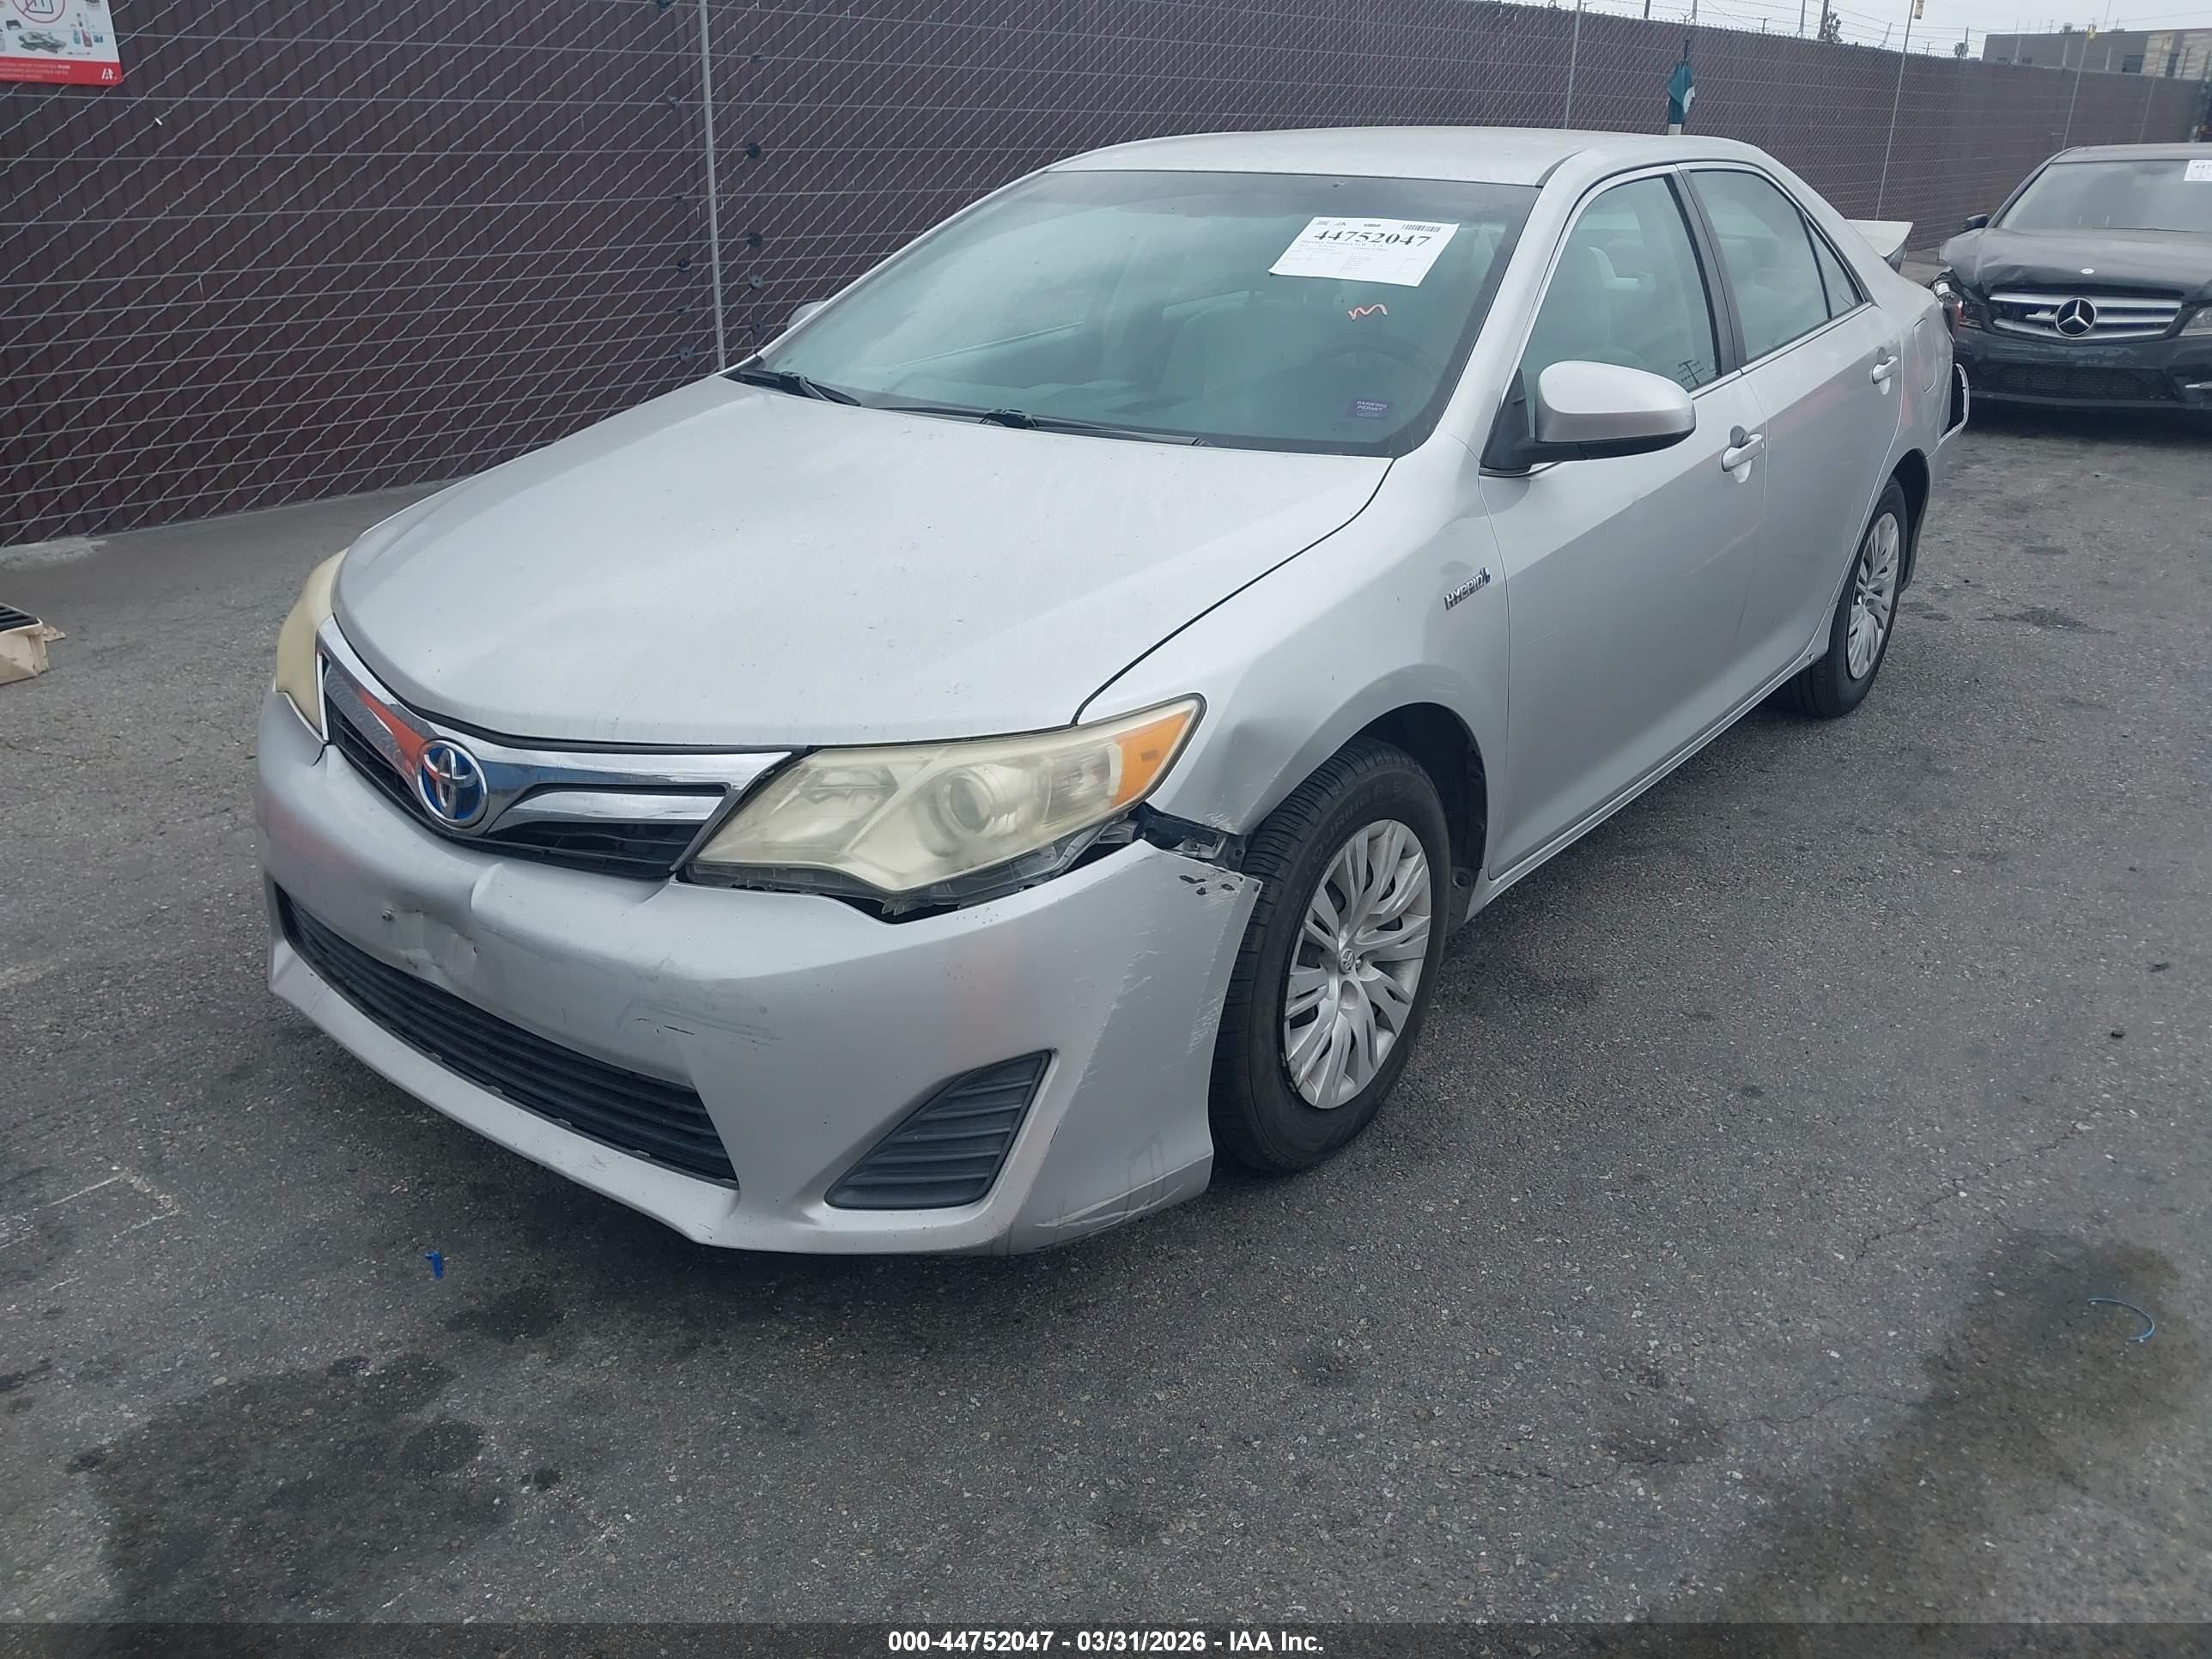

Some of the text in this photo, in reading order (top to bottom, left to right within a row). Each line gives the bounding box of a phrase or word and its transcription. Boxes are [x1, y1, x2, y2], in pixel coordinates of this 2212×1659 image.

[1313, 229, 1431, 247] 44752047
[1356, 400, 1387, 409] PARKING
[1443, 568, 1490, 611] HYBRID
